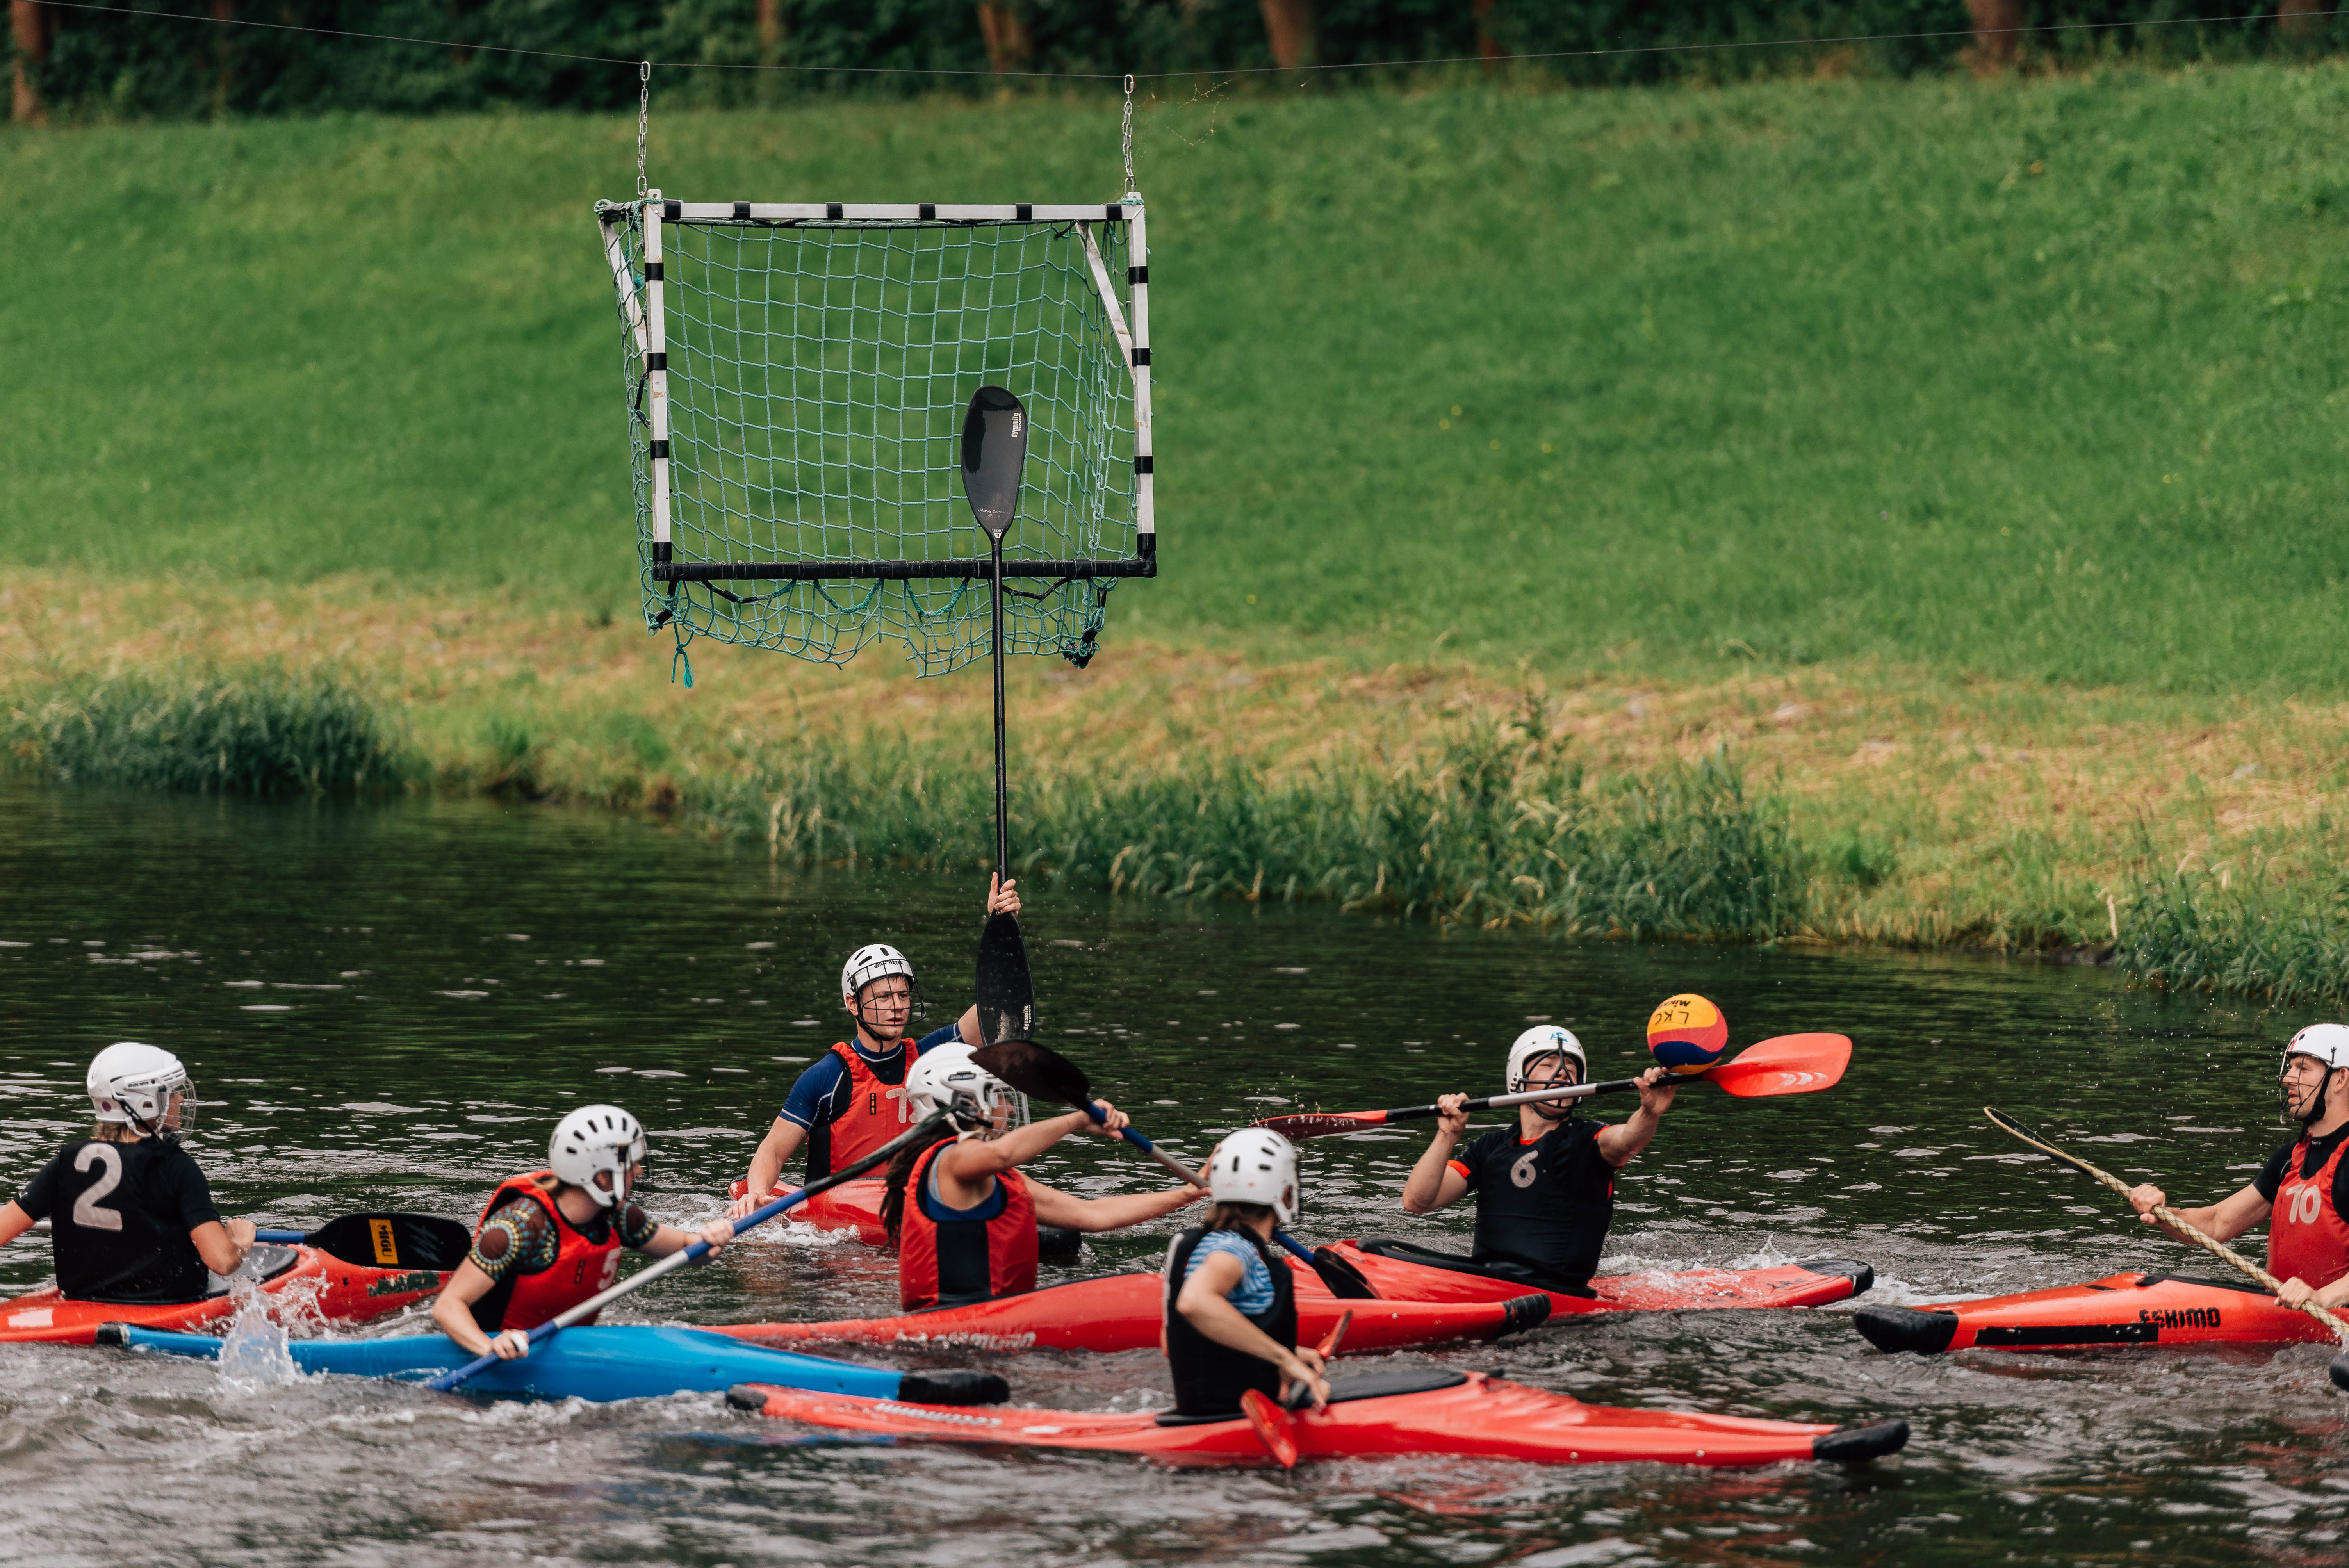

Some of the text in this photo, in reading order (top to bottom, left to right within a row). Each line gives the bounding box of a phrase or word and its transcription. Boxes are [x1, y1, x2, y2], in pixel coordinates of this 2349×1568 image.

[73, 1142, 122, 1231] 2
[1511, 1150, 1538, 1187] 6
[2286, 1184, 2321, 1224] 10
[378, 1225, 393, 1256] MIGU
[597, 1247, 622, 1290] 5
